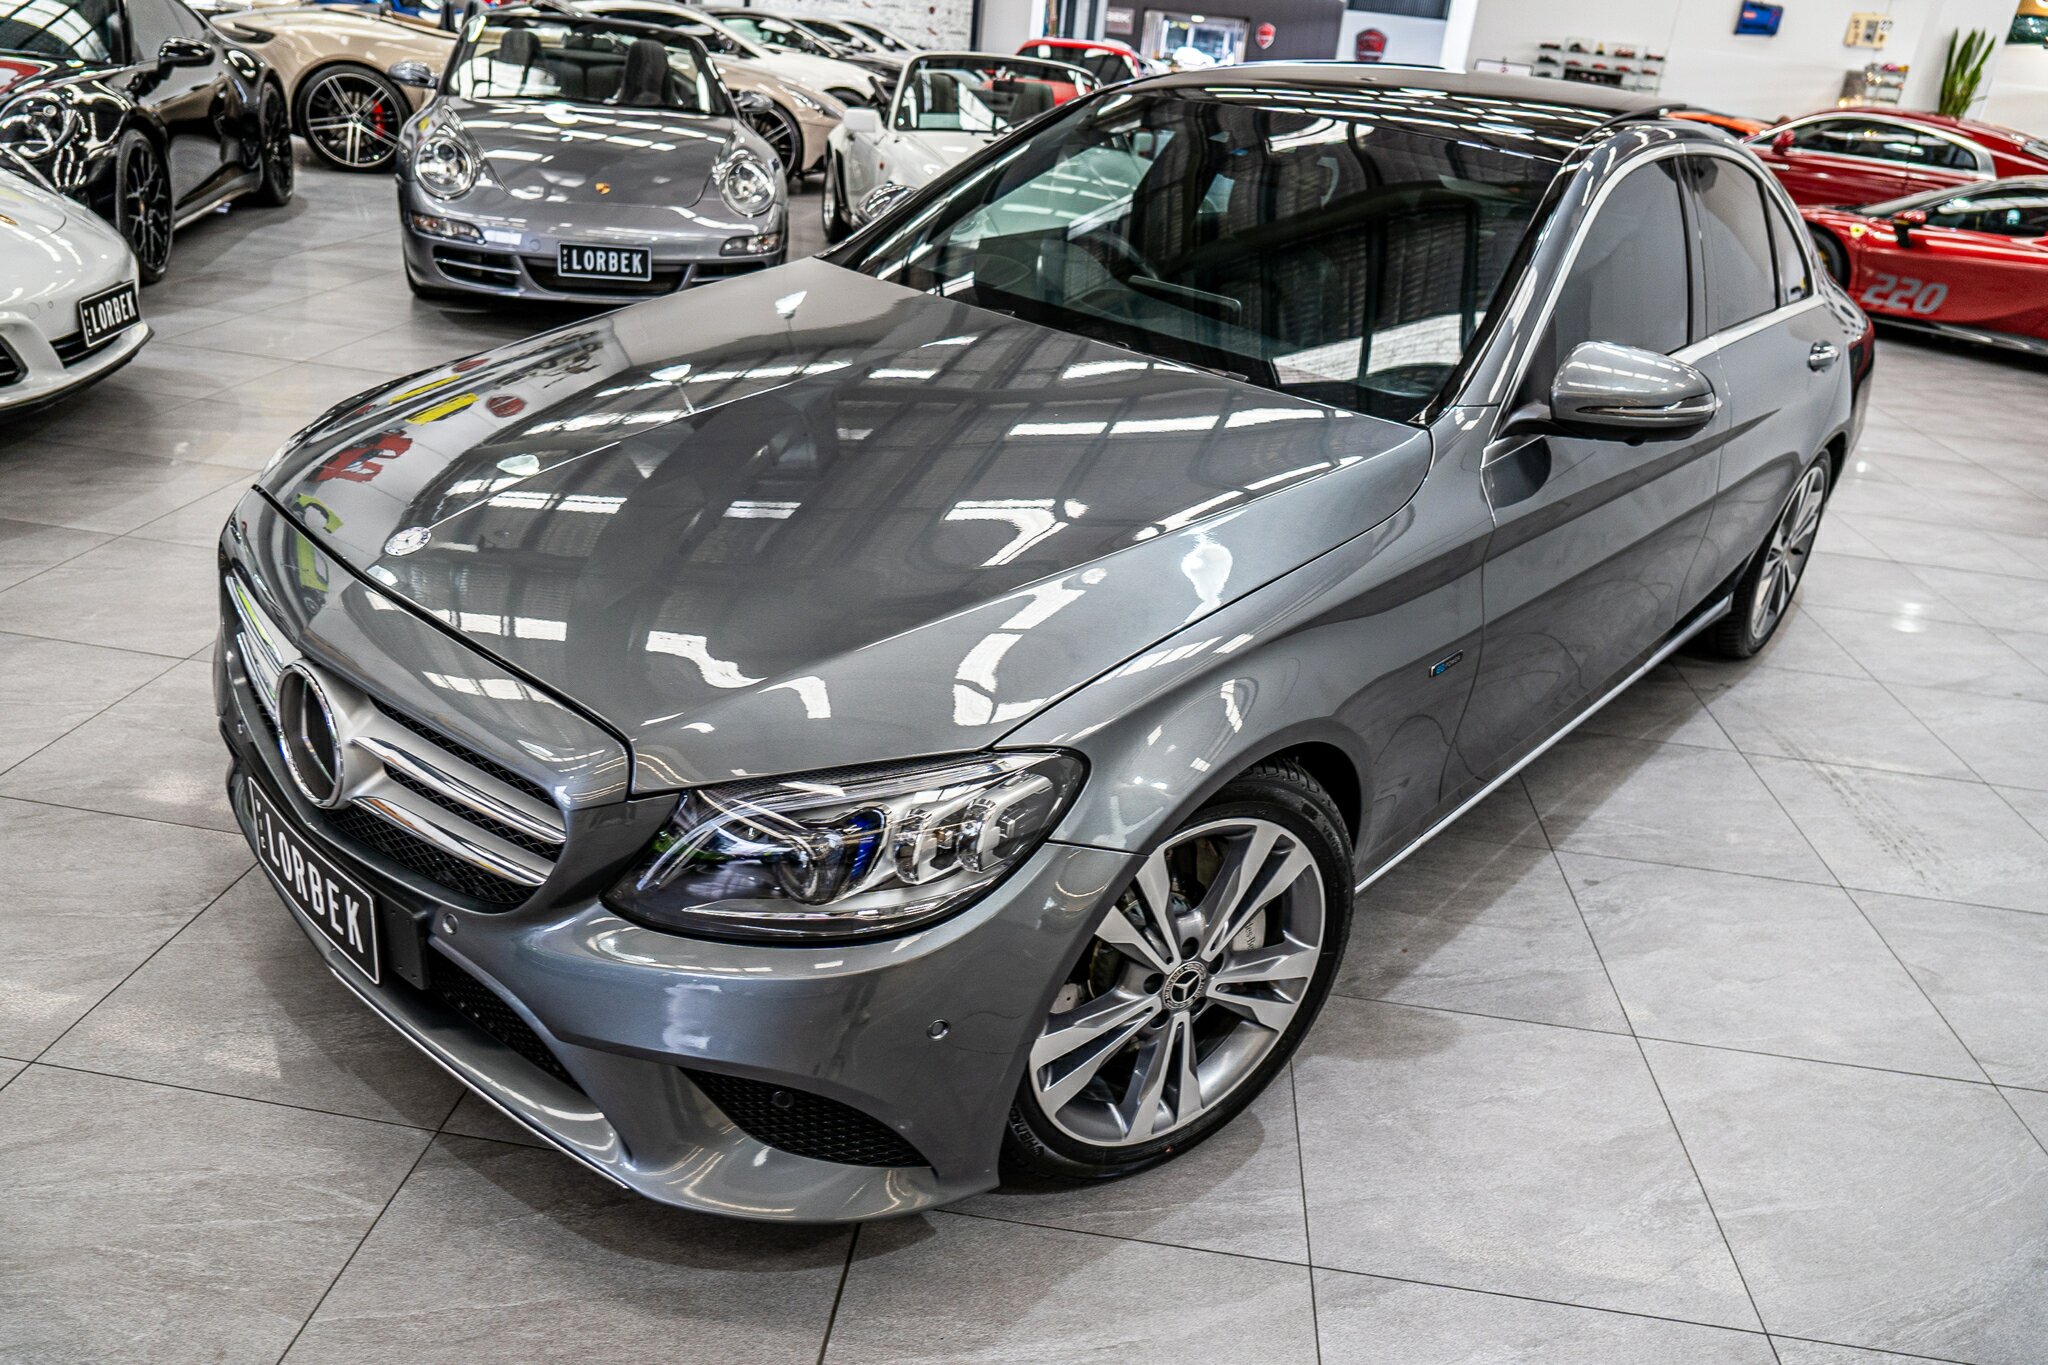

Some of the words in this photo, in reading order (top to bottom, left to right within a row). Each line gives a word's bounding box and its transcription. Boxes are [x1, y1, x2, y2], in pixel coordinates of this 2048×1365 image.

[571, 249, 643, 274] LORBEK
[90, 291, 137, 333] LORBEK
[1861, 273, 1949, 314] 220
[265, 812, 365, 954] LORBEK
